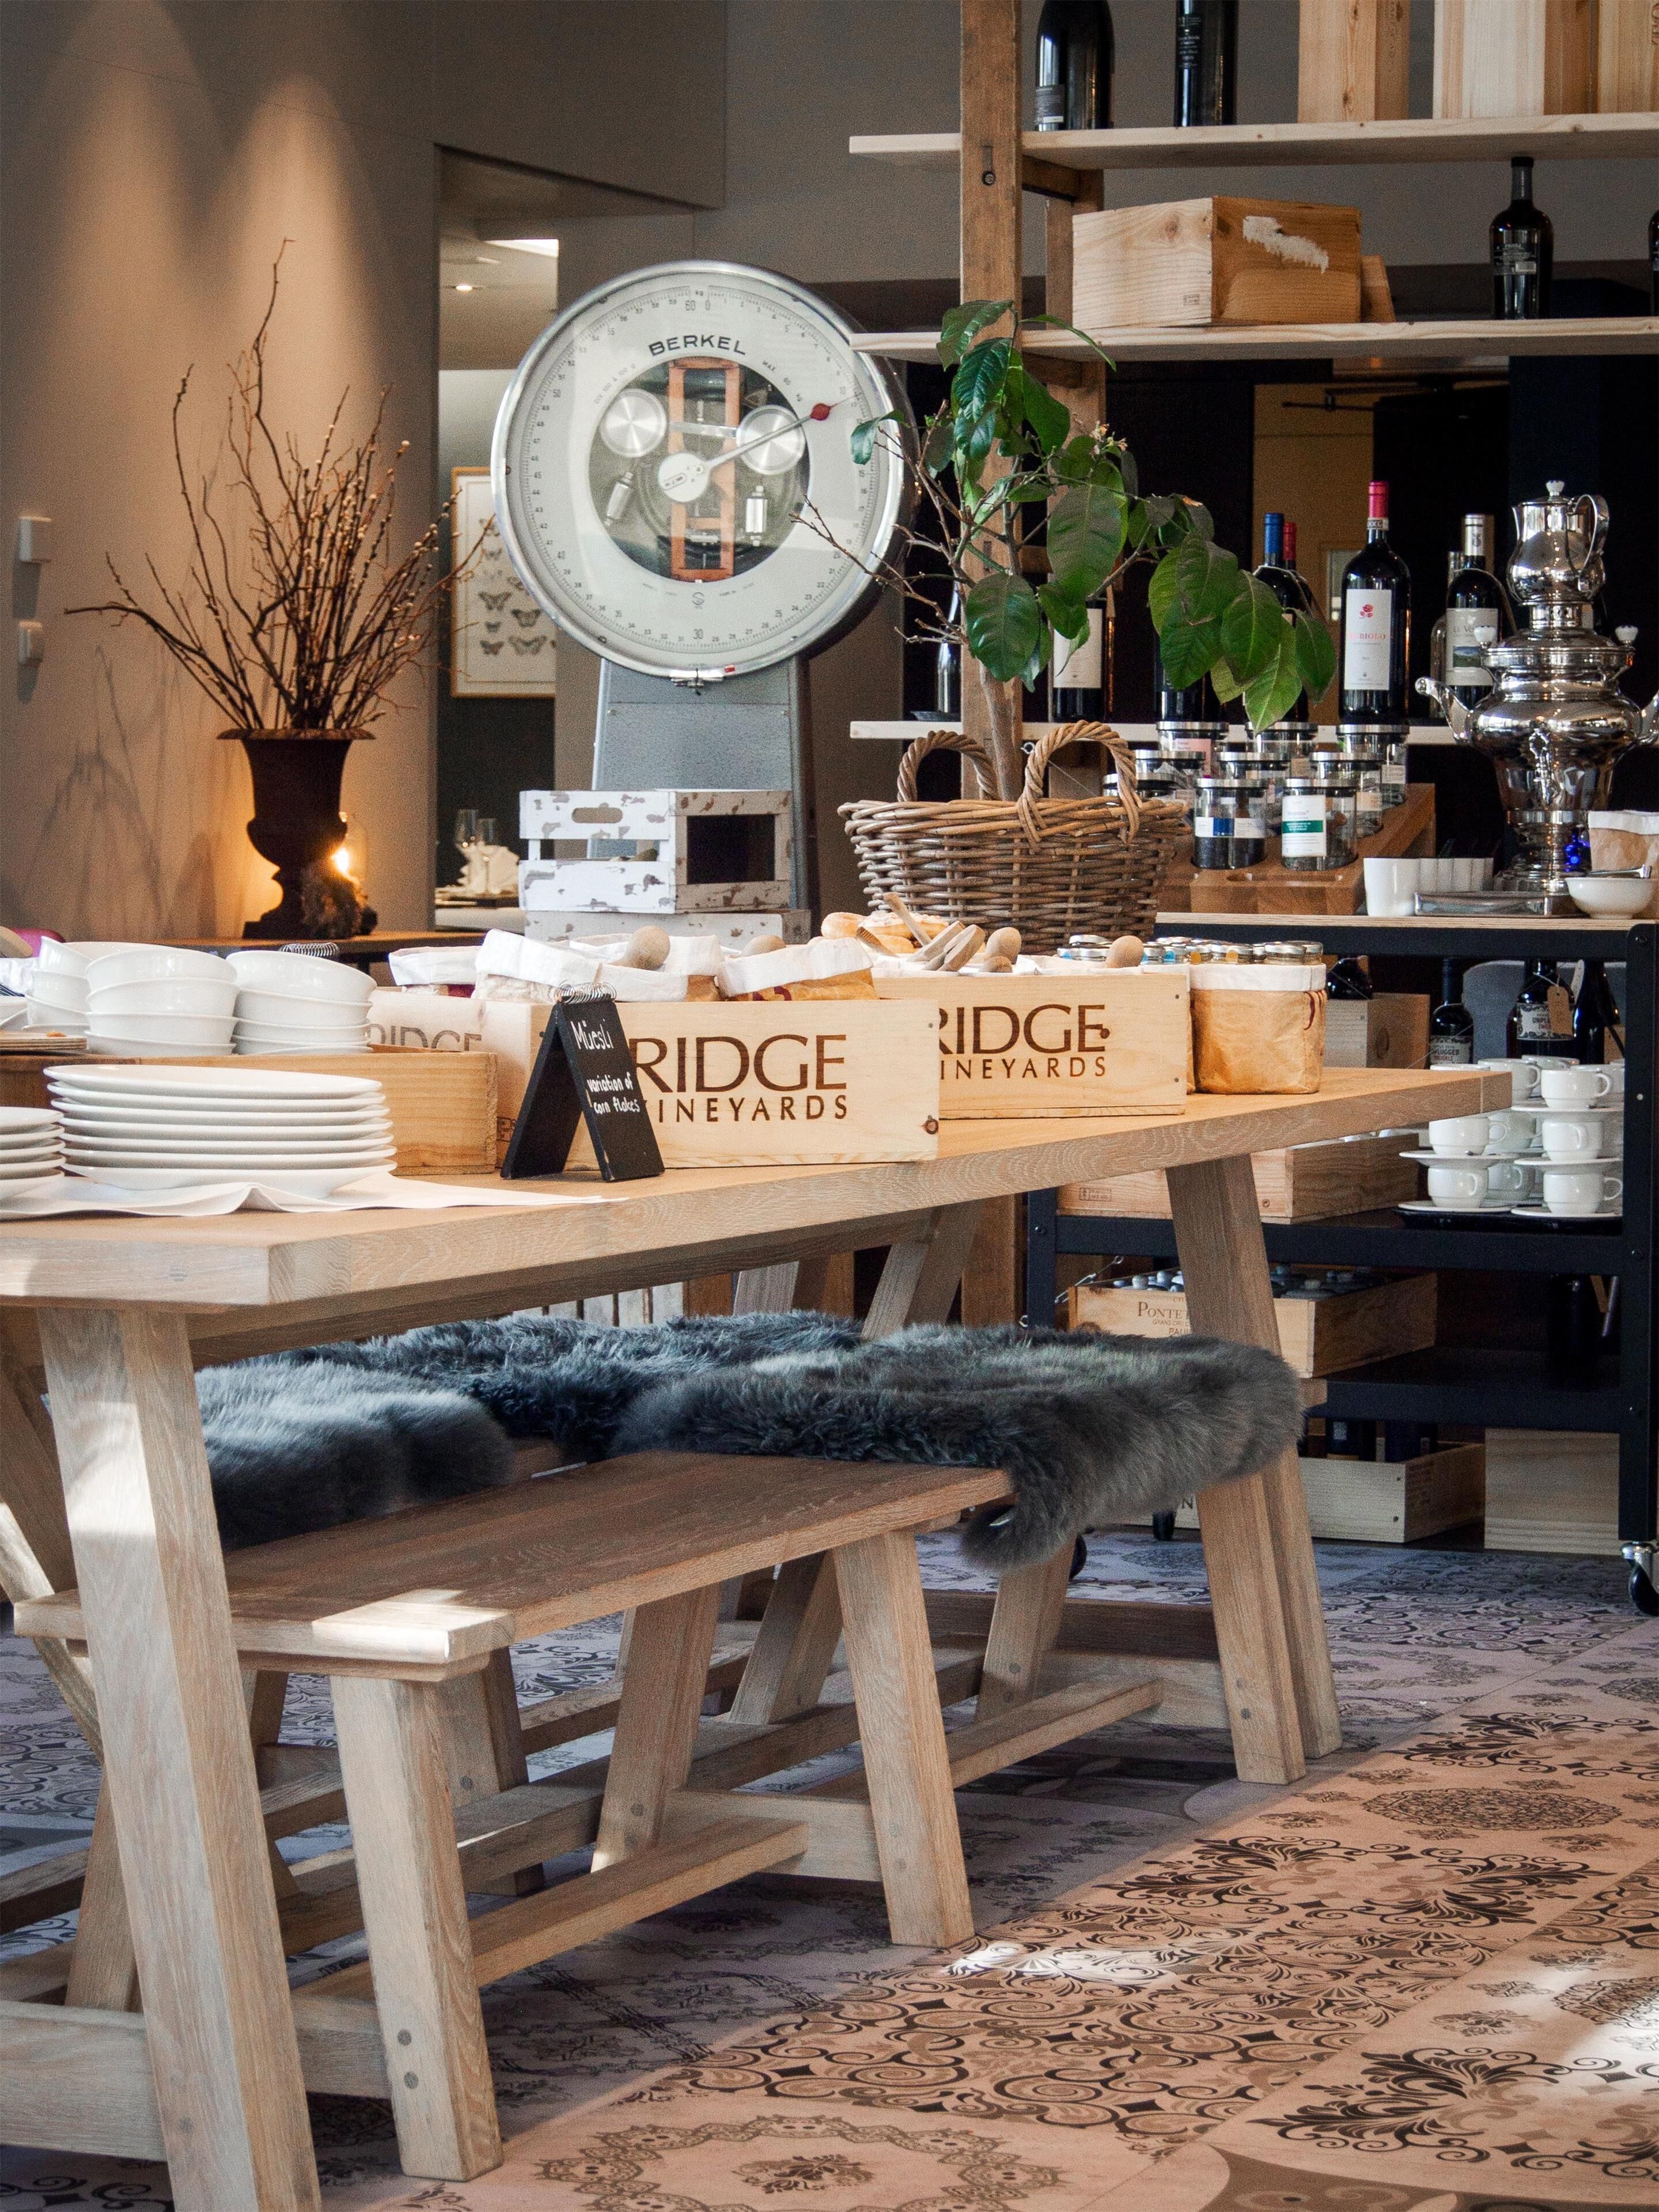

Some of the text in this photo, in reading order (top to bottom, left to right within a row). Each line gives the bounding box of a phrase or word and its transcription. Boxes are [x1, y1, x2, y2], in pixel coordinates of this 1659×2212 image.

[649, 334, 747, 356] BERKEL
[693, 628, 704, 639] 30
[570, 1018, 614, 1050] Müesli
[628, 1034, 847, 1093] RIDGE
[940, 1056, 1106, 1081] INEYARDS
[586, 1071, 634, 1093] variation of
[593, 1096, 641, 1114] corn flakes
[644, 1094, 847, 1123] INEYARDS
